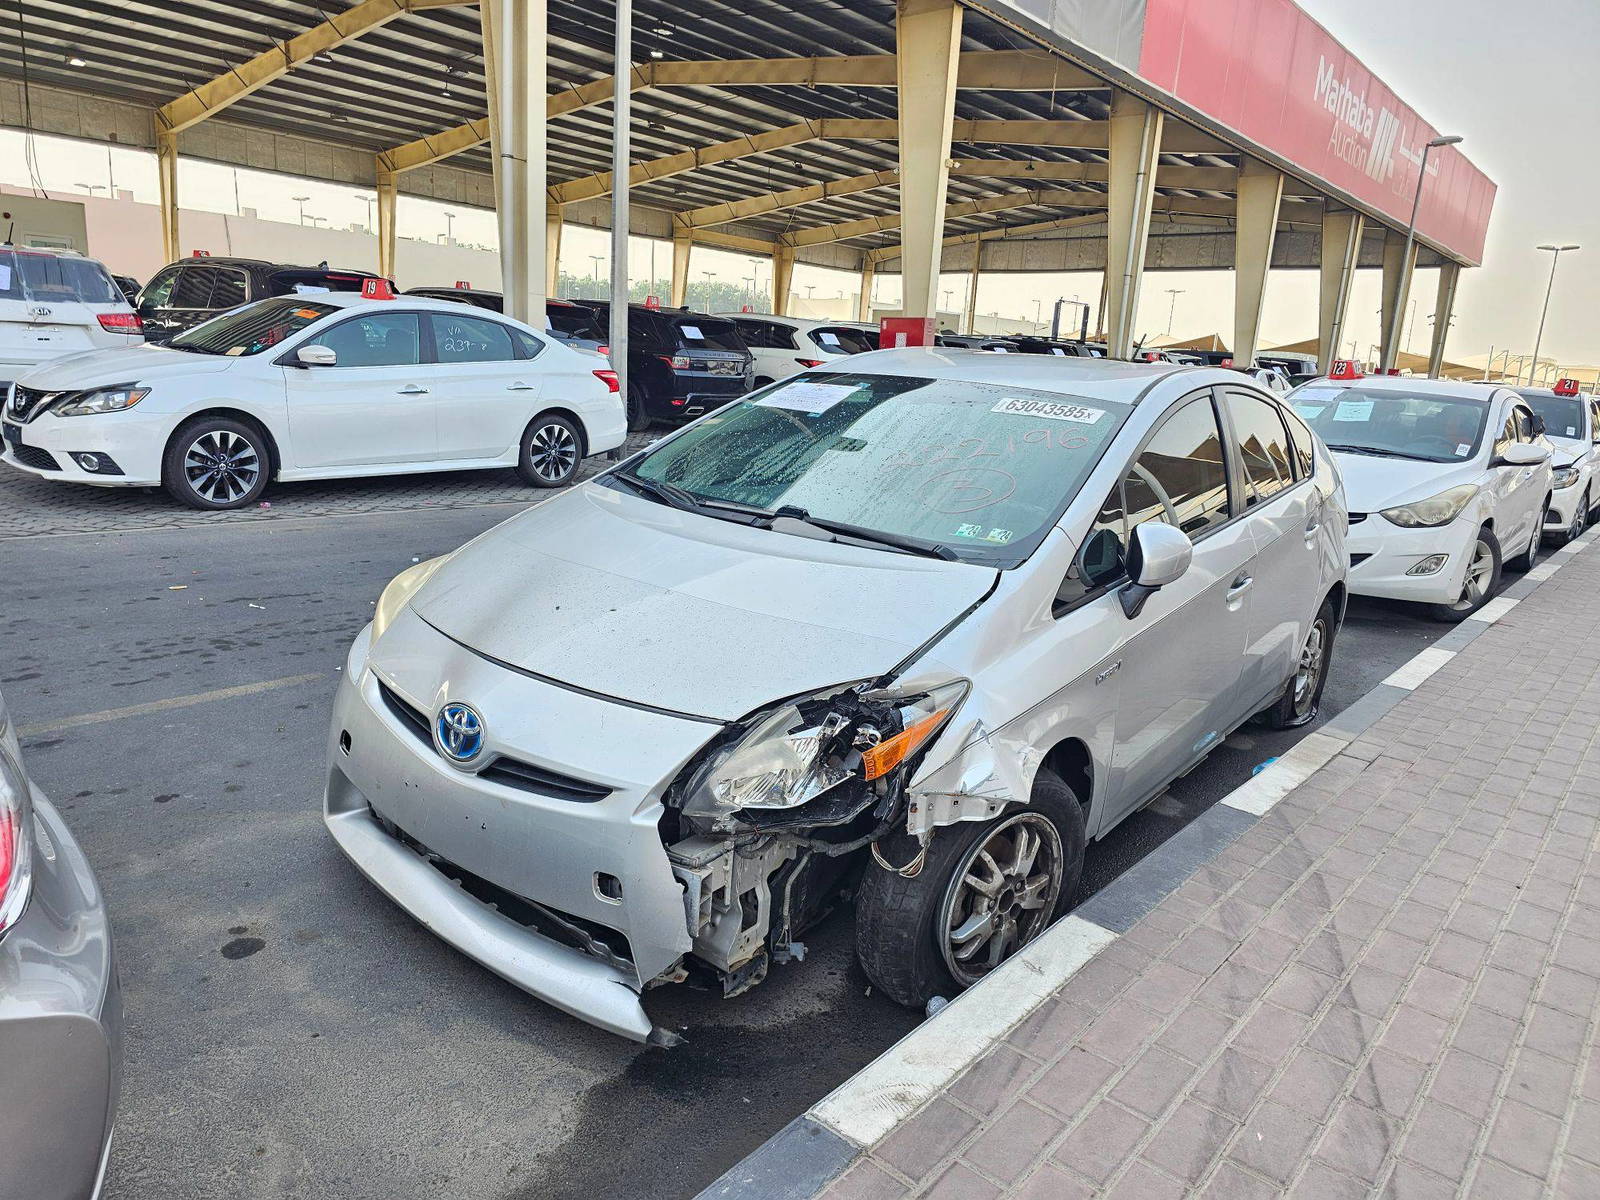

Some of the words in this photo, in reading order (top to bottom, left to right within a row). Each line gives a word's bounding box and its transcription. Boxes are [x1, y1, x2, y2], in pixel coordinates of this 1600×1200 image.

[1314, 55, 1374, 139] Marhaba
[1329, 120, 1367, 170] Auction
[367, 280, 376, 295] 19
[1564, 380, 1574, 390] 21
